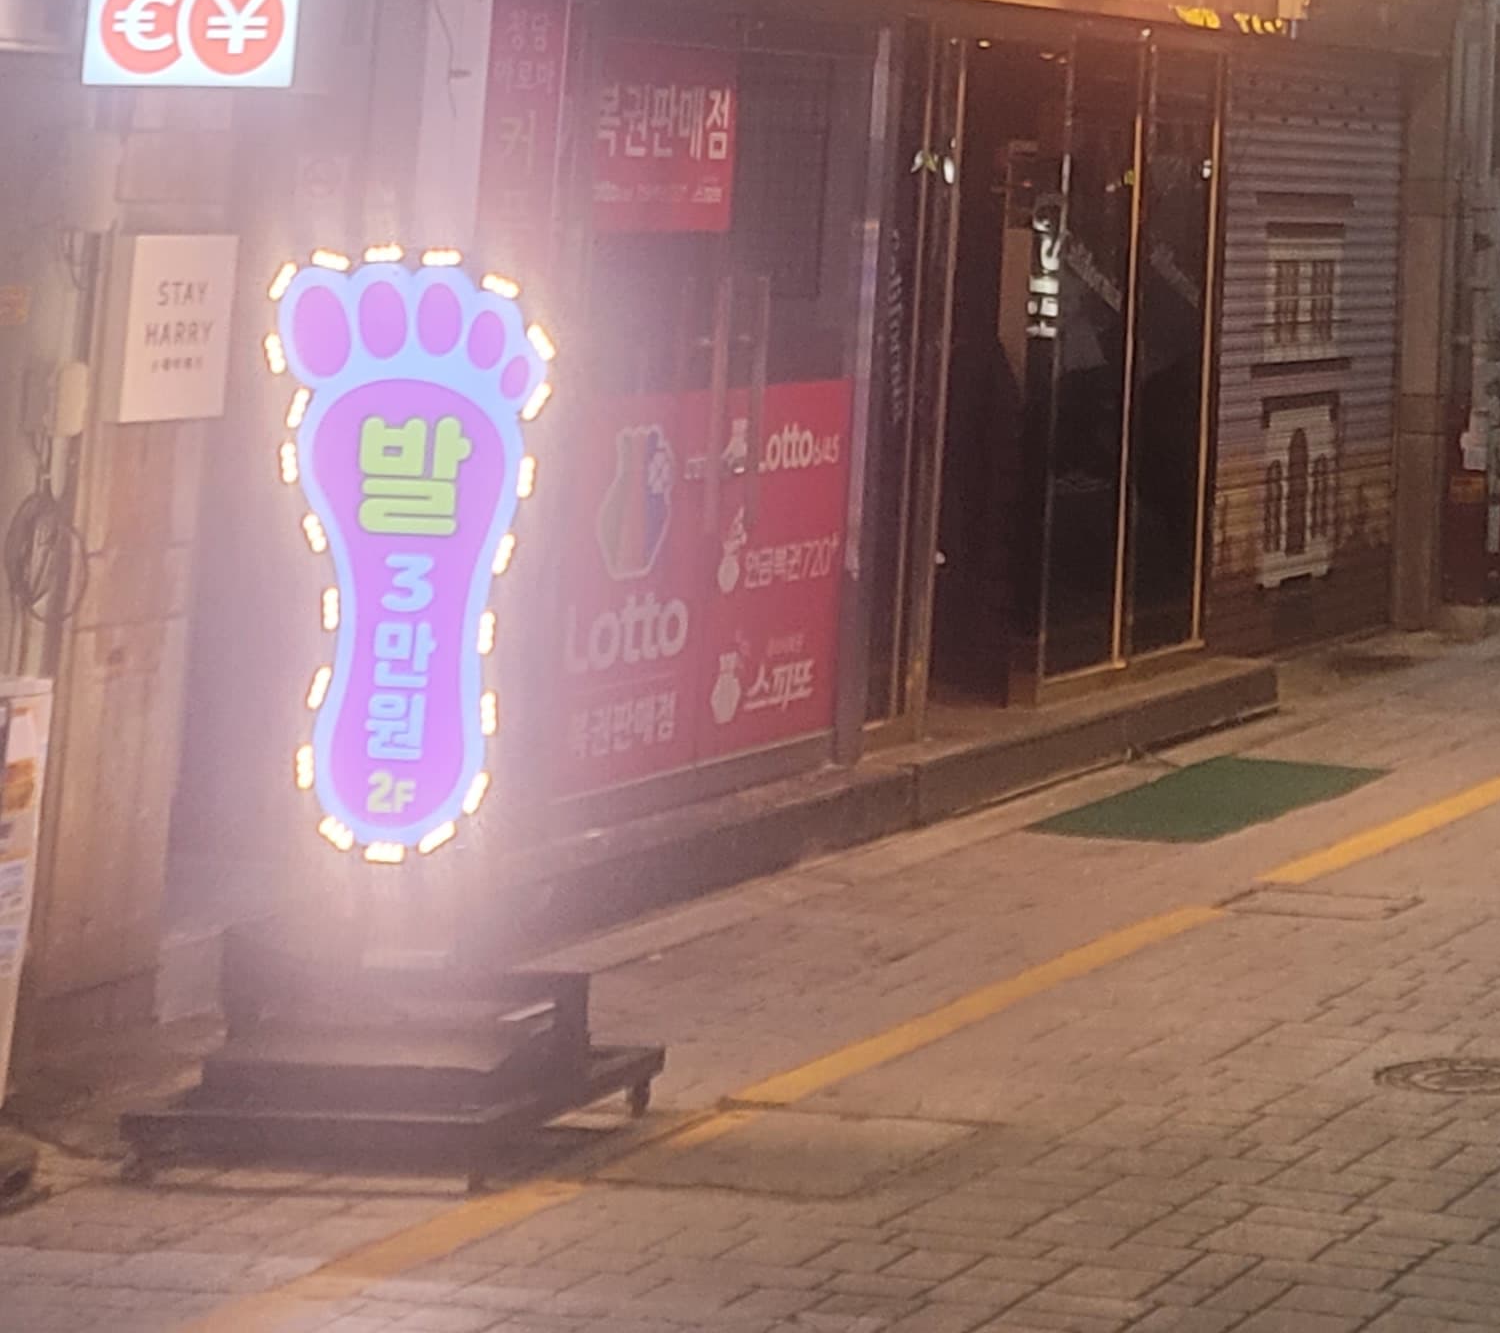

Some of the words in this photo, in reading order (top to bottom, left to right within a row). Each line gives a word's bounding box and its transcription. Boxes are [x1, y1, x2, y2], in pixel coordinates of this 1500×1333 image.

[358, 415, 472, 537] 발
[563, 590, 690, 675] Lotto
[366, 772, 416, 814] 2F
